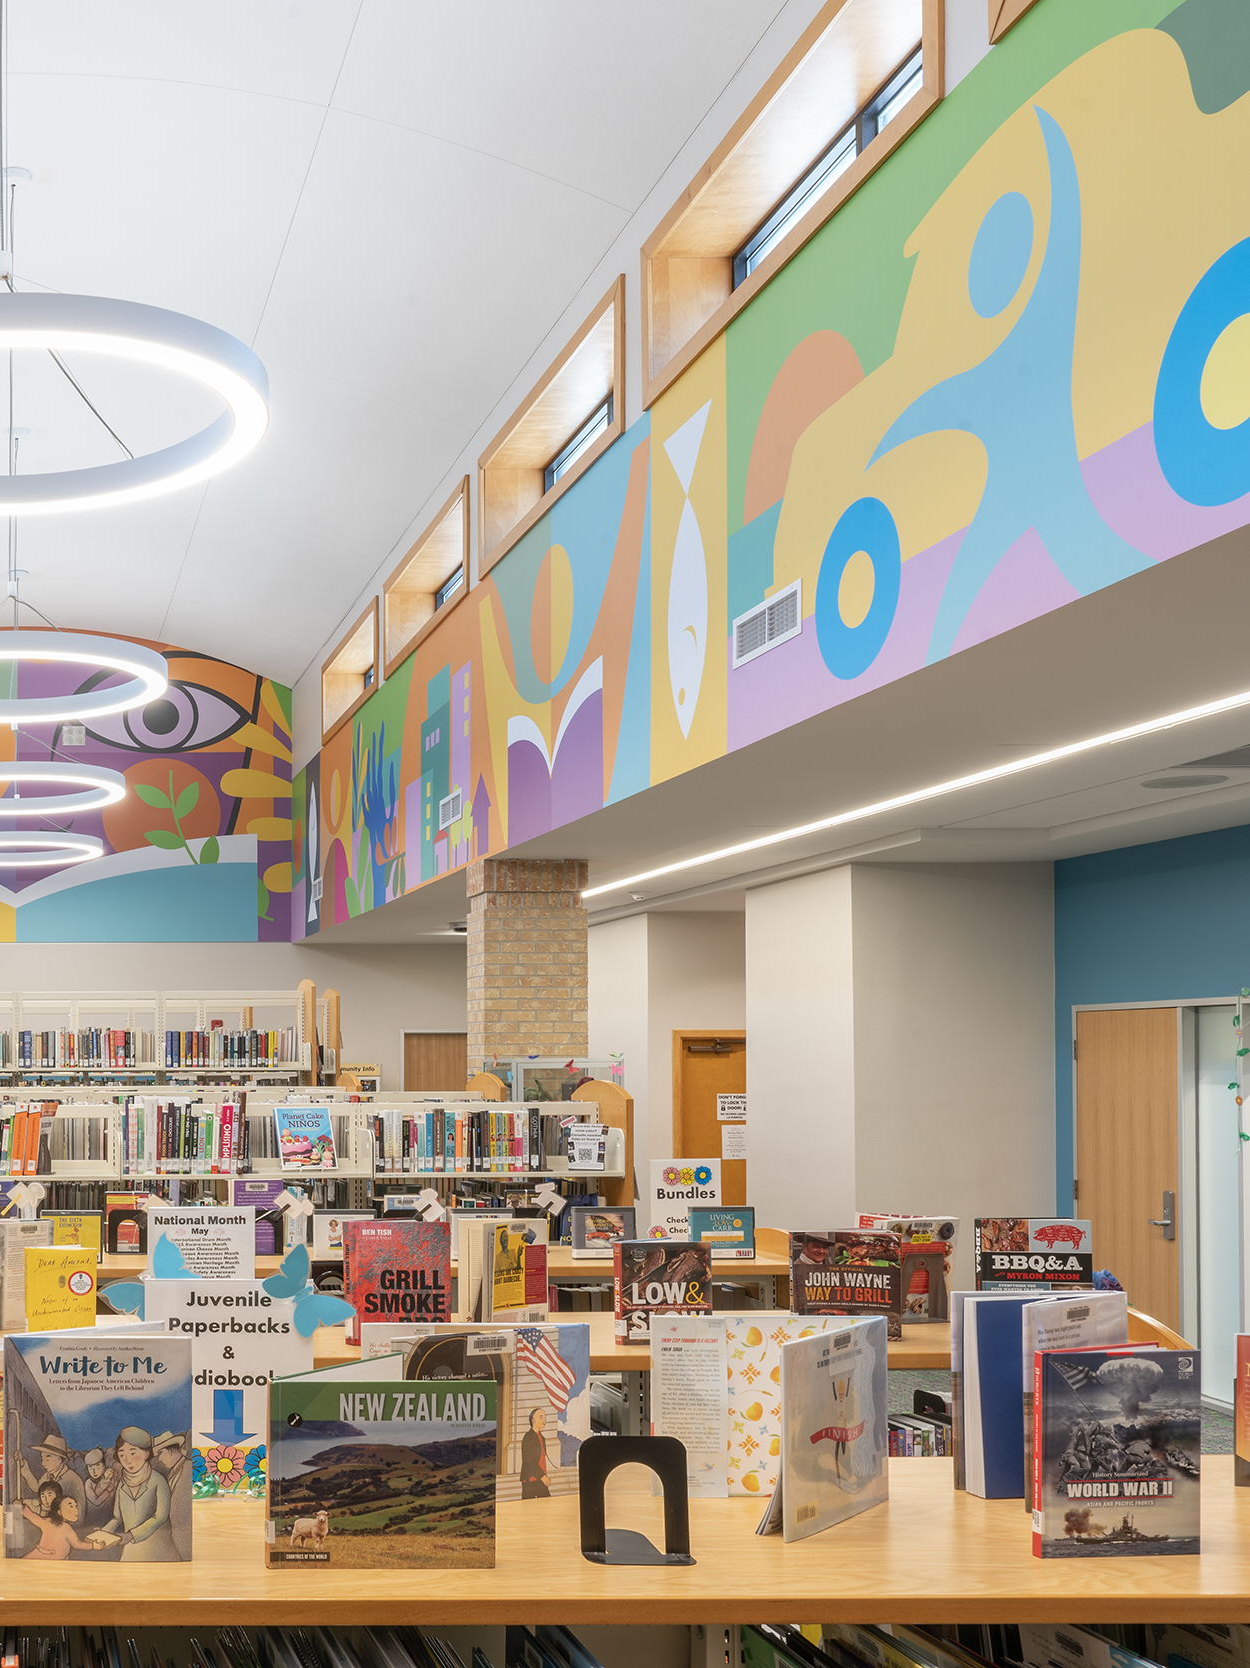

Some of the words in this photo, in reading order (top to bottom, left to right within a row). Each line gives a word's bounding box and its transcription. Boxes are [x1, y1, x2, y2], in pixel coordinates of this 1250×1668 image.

[656, 1188, 716, 1200] Bundles
[154, 1216, 205, 1226] National
[208, 1215, 246, 1226] Month
[191, 1228, 209, 1236] May
[992, 1255, 1083, 1273] BBQ&A
[380, 1270, 446, 1290] GRILL
[804, 1272, 840, 1287] JOHN
[844, 1272, 891, 1289] WAYNE
[186, 1291, 272, 1308] Juvenile
[364, 1293, 446, 1314] SMOKE
[804, 1286, 832, 1301] WAY
[834, 1287, 850, 1301] TO
[854, 1288, 892, 1304] GRILL
[168, 1316, 290, 1338] Paperbacks
[222, 1345, 236, 1360] &
[40, 1356, 103, 1376] Write
[104, 1356, 128, 1376] to
[132, 1356, 168, 1374] Me
[192, 1369, 279, 1386] dioboo
[339, 1393, 389, 1422] NEW
[391, 1393, 486, 1422] ZEALAND
[822, 1428, 859, 1439] FINISH
[1067, 1482, 1119, 1498] WORLD
[1123, 1482, 1158, 1497] WAR
[1162, 1480, 1172, 1496] II
